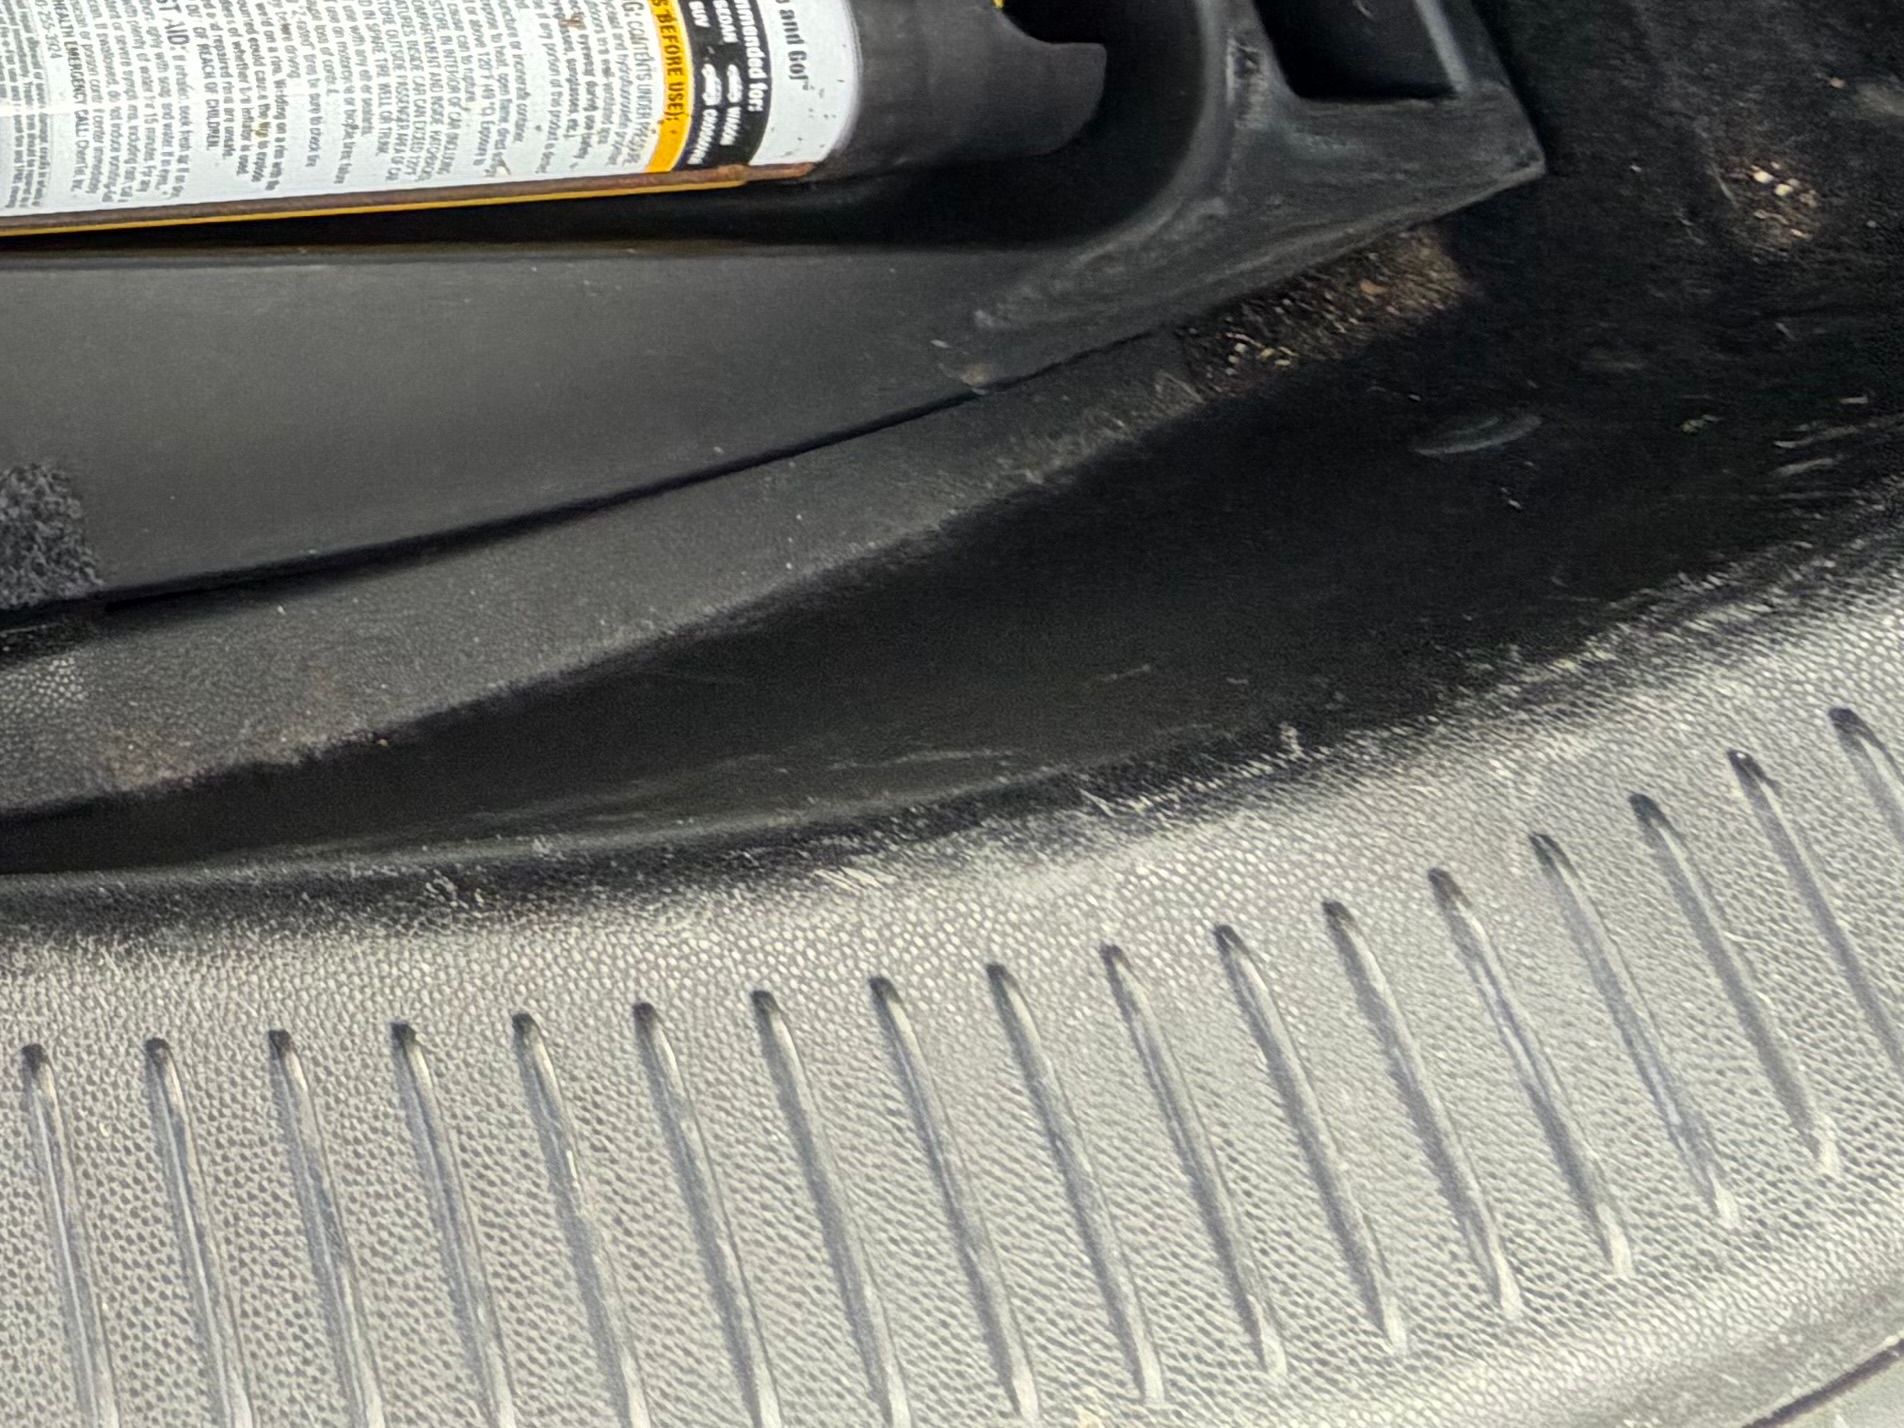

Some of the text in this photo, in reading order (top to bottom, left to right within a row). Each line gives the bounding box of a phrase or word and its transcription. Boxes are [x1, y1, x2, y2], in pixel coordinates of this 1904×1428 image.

[687, 0, 710, 28] SUV
[778, 8, 805, 45] and
[195, 42, 216, 80] REACH
[654, 13, 686, 77] BEFORE
[62, 39, 88, 105] EMERGENCY
[202, 80, 219, 95] OF
[664, 79, 686, 122] USE):
[747, 81, 767, 112] for:
